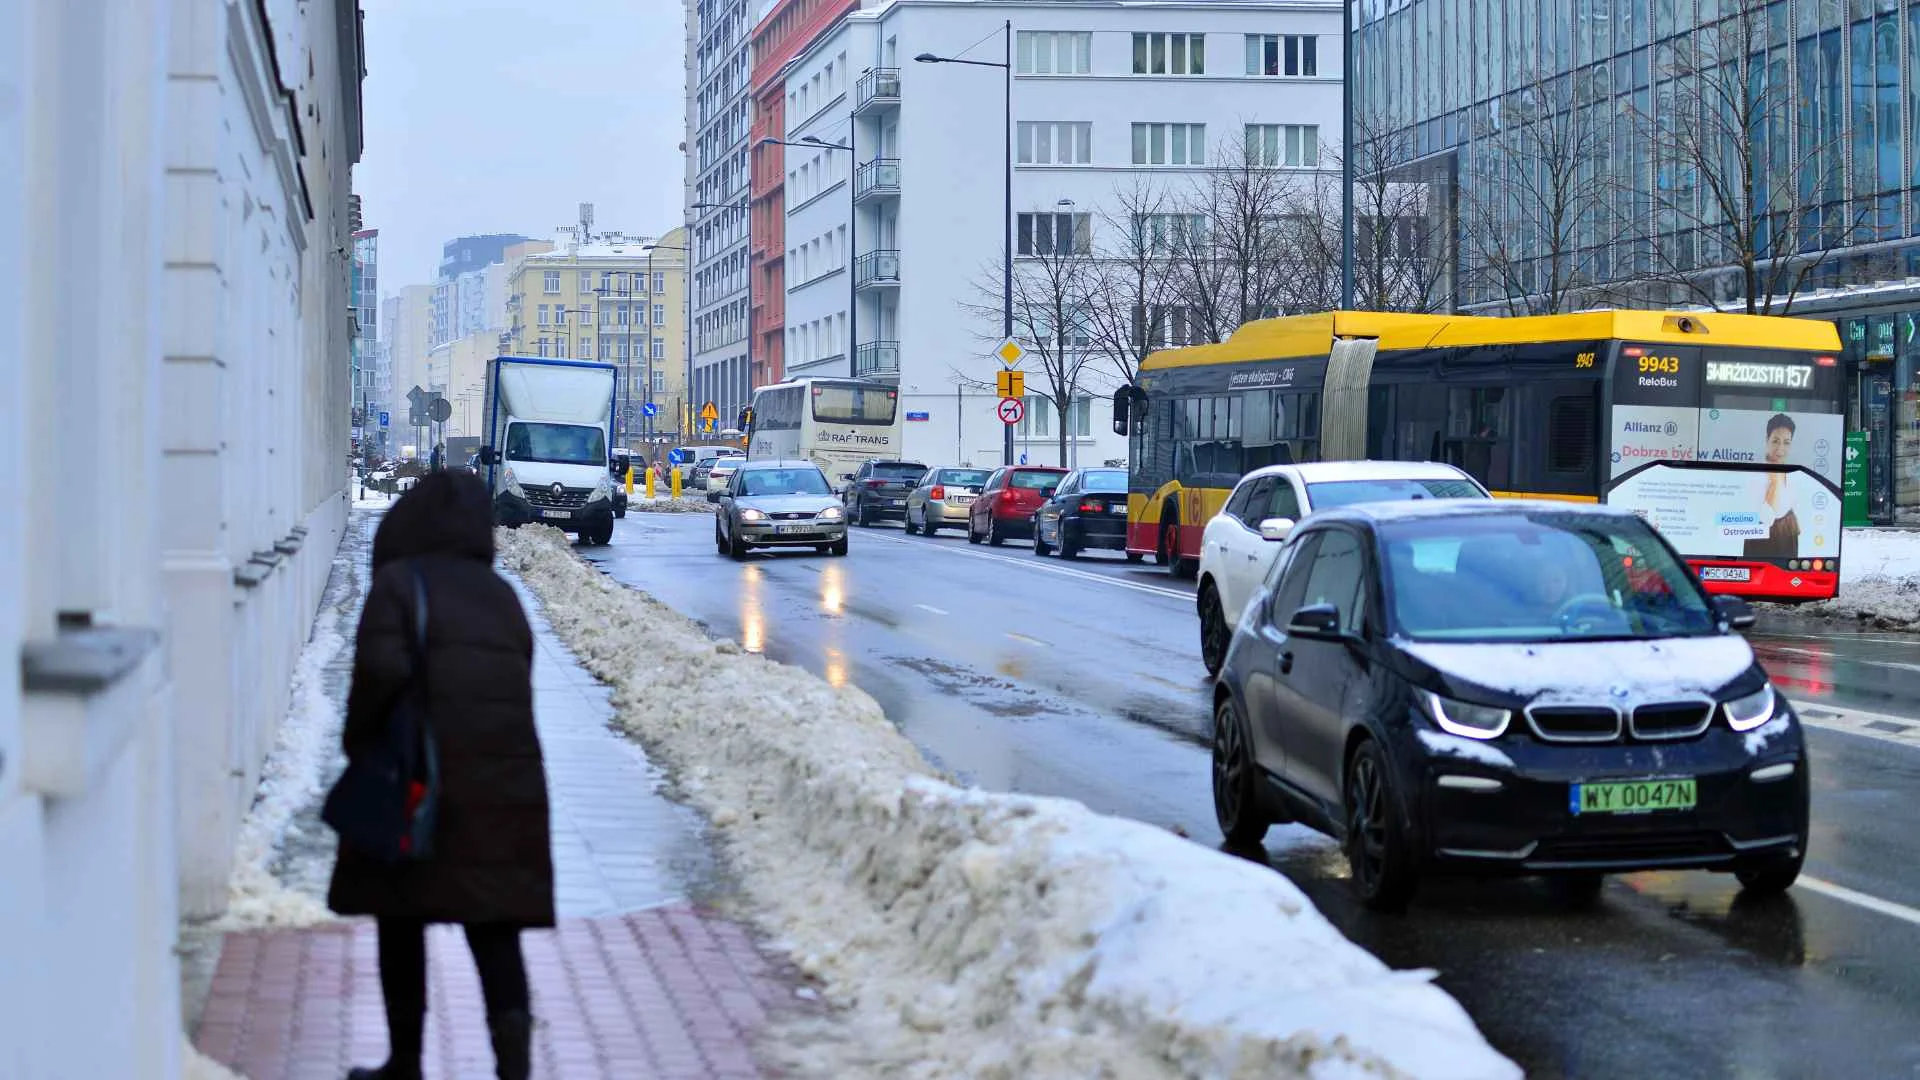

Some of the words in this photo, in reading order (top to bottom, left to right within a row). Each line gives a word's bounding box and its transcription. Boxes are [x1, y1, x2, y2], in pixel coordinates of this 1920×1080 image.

[1576, 352, 1595, 368] 9943
[1638, 356, 1679, 373] 9943
[1639, 376, 1678, 387] ReloBus
[1786, 364, 1812, 388] 157
[1624, 421, 1661, 433] Allianz
[832, 434, 852, 443] RAF
[855, 435, 889, 445] TRANS
[1622, 445, 1667, 458] Dobrze
[1672, 446, 1693, 460] być
[1699, 450, 1708, 459] w
[1712, 448, 1755, 461] Allianz
[1721, 513, 1754, 523] Karolina
[1723, 528, 1764, 536] Ostrowska
[1705, 568, 1721, 579] WSC
[1585, 785, 1613, 808] WY
[1623, 783, 1692, 807] 0047N
